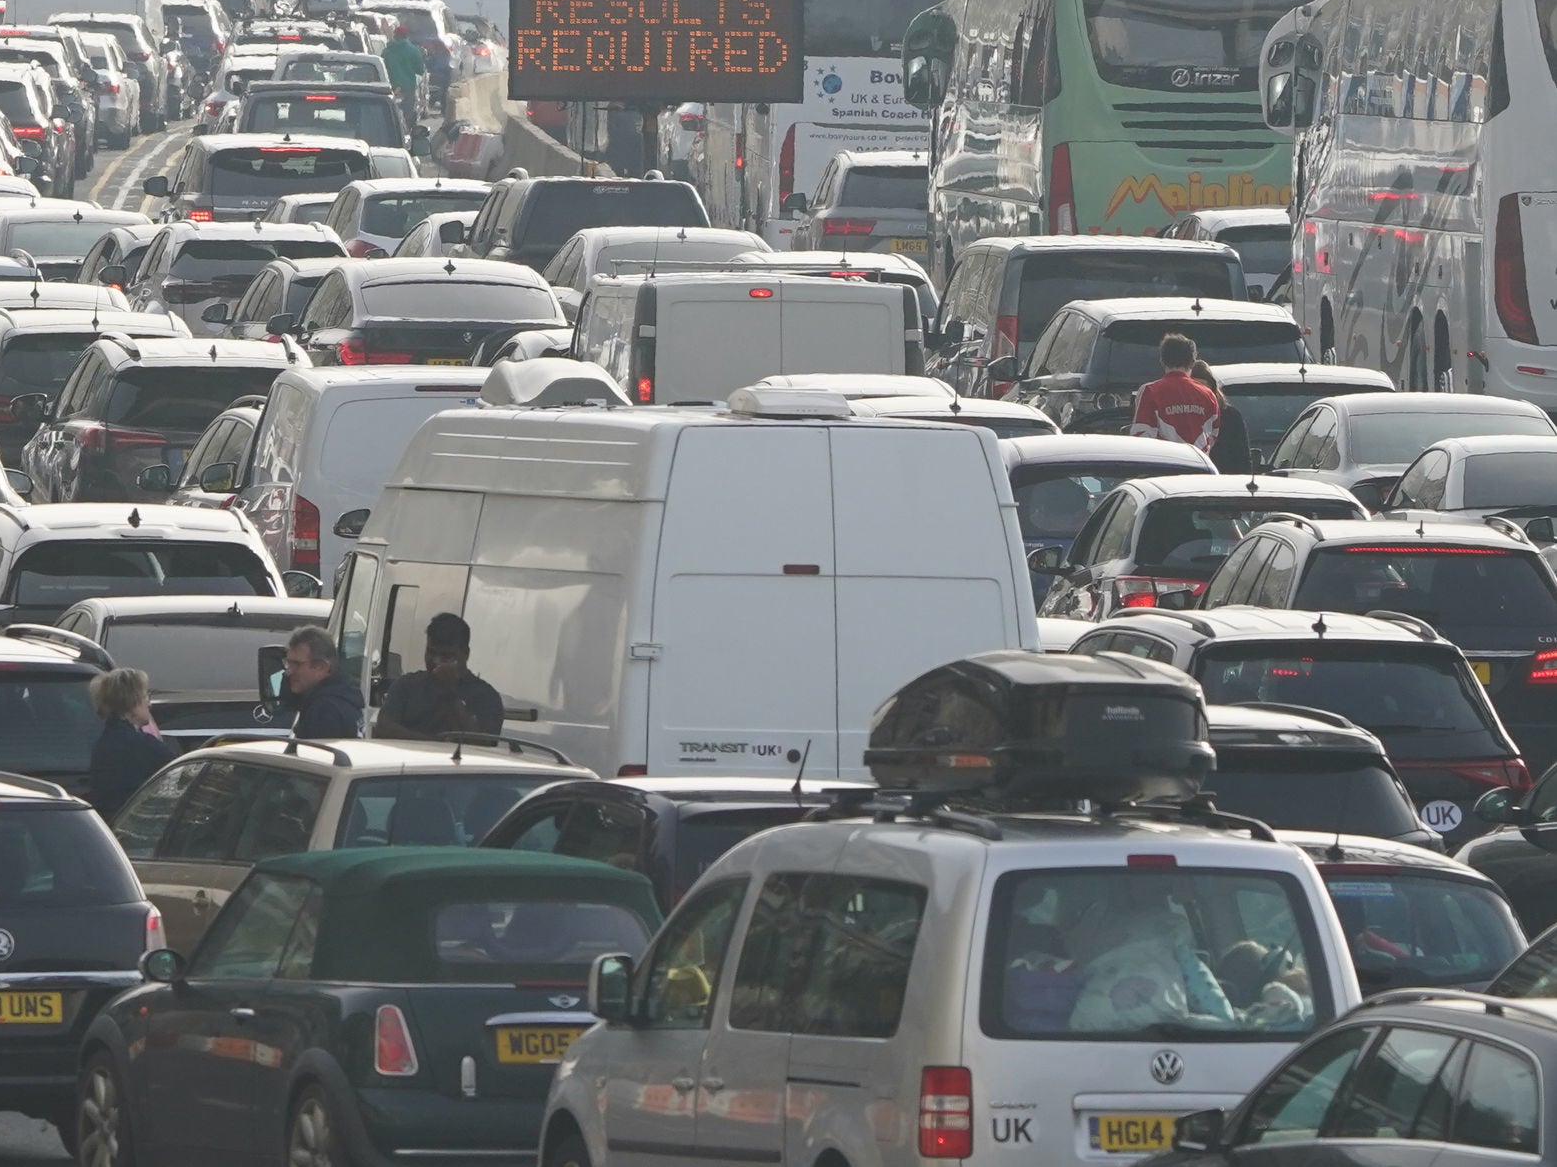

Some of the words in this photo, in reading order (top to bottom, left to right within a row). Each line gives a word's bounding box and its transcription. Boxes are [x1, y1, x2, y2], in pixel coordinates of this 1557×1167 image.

[517, 30, 788, 73] REQUIRED
[851, 94, 868, 104] UK
[871, 94, 880, 104] &
[832, 108, 878, 119] Spanish
[881, 109, 918, 120] Coach
[678, 742, 750, 753] TRANSIT
[756, 744, 778, 756] UK
[1425, 805, 1457, 826] UK
[9, 995, 54, 1018] UNS
[991, 1117, 1034, 1143] UK
[1106, 1121, 1165, 1145] HG14
